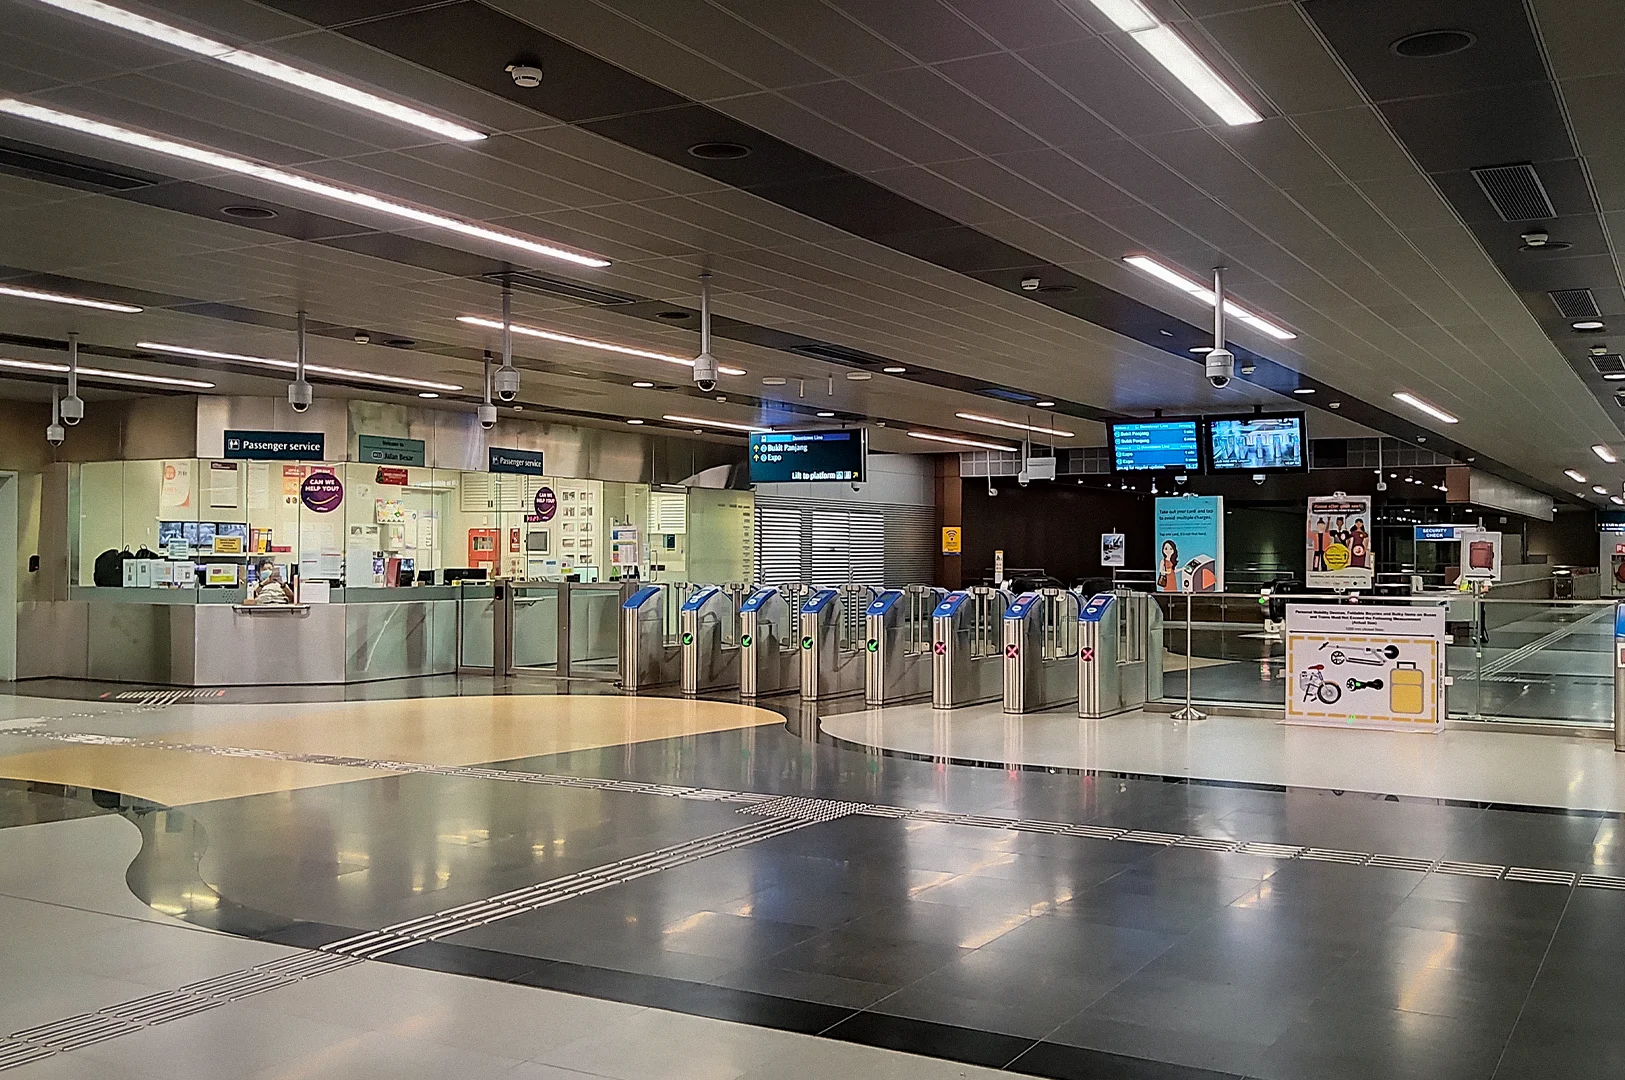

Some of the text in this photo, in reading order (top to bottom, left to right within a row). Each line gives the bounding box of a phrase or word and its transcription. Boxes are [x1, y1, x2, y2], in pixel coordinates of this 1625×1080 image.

[243, 440, 320, 451] Passenger service
[768, 444, 808, 452] Bukit Panjang
[500, 457, 541, 467] Passenger service
[768, 454, 782, 462] Expo
[810, 471, 835, 480] platform
